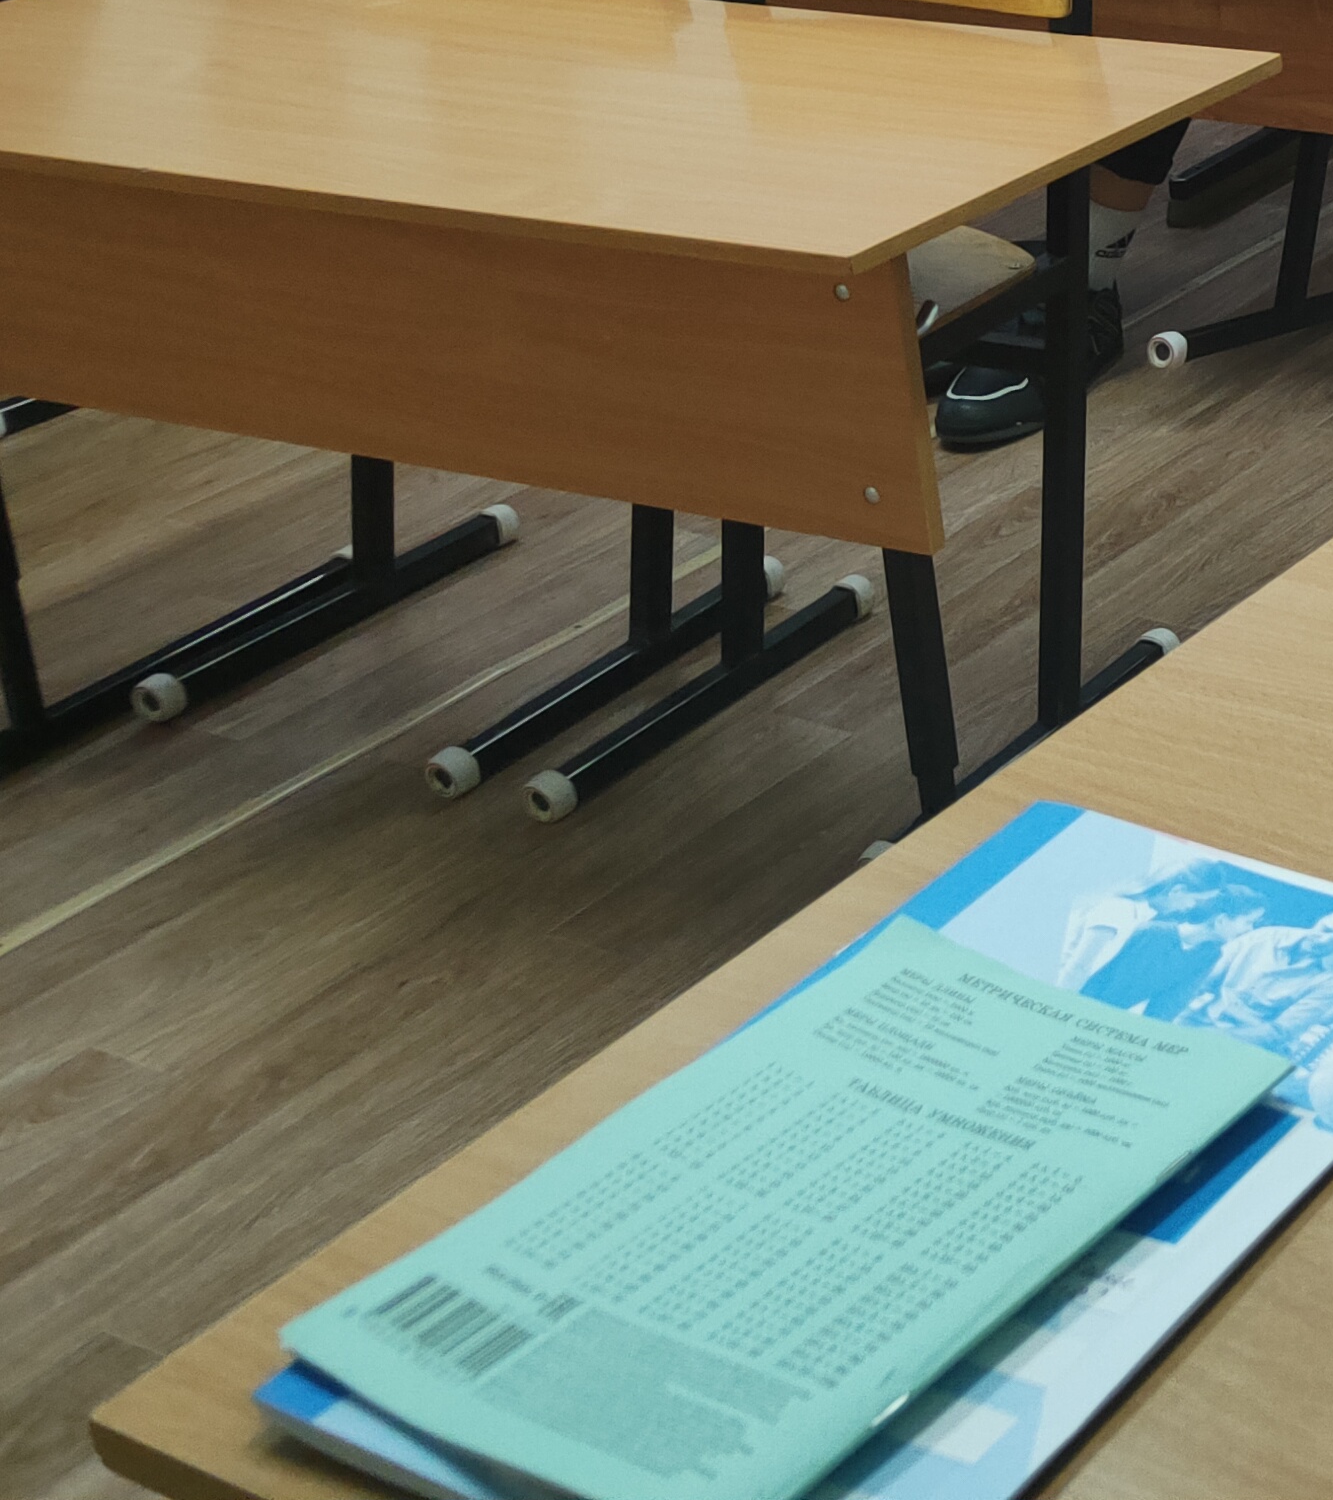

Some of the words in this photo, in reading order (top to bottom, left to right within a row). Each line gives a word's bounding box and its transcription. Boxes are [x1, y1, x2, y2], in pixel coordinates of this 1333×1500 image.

[957, 973, 1074, 1023] МЕТРИЧЕСКАЯ
[1076, 1018, 1149, 1047] СИСТЕМА
[926, 1100, 1037, 1150] УМНОЖЕНИЯ
